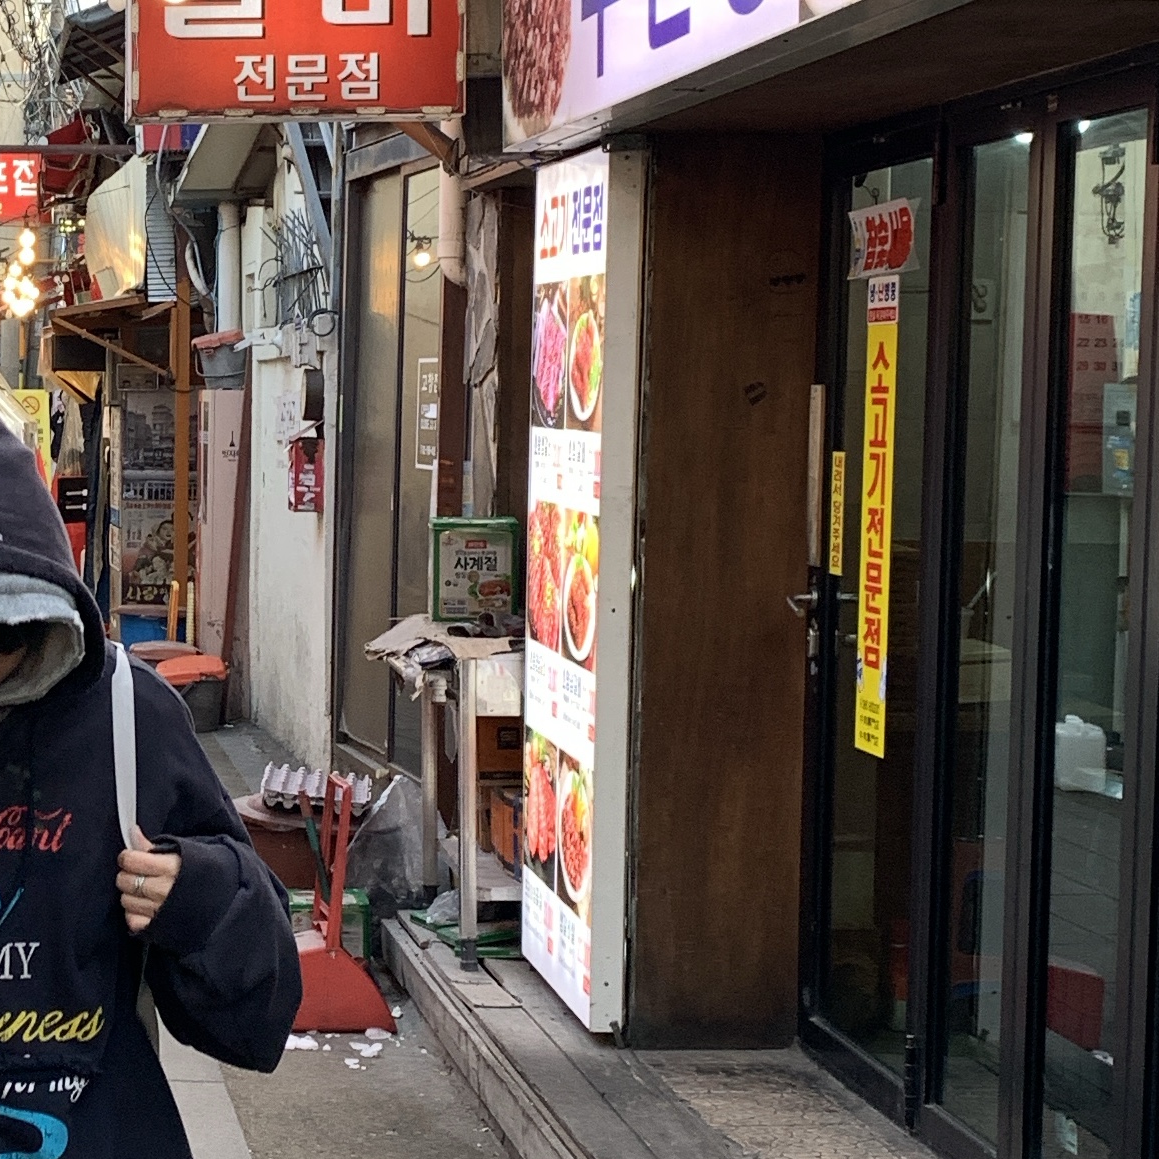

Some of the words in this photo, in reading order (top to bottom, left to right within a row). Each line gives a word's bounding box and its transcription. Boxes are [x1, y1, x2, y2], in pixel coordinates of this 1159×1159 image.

[233, 52, 381, 102] 전문점
[540, 191, 569, 259] 소고기
[572, 182, 604, 255] 전문점
[863, 341, 891, 671] 소고기전문점
[453, 556, 498, 572] 사계절
